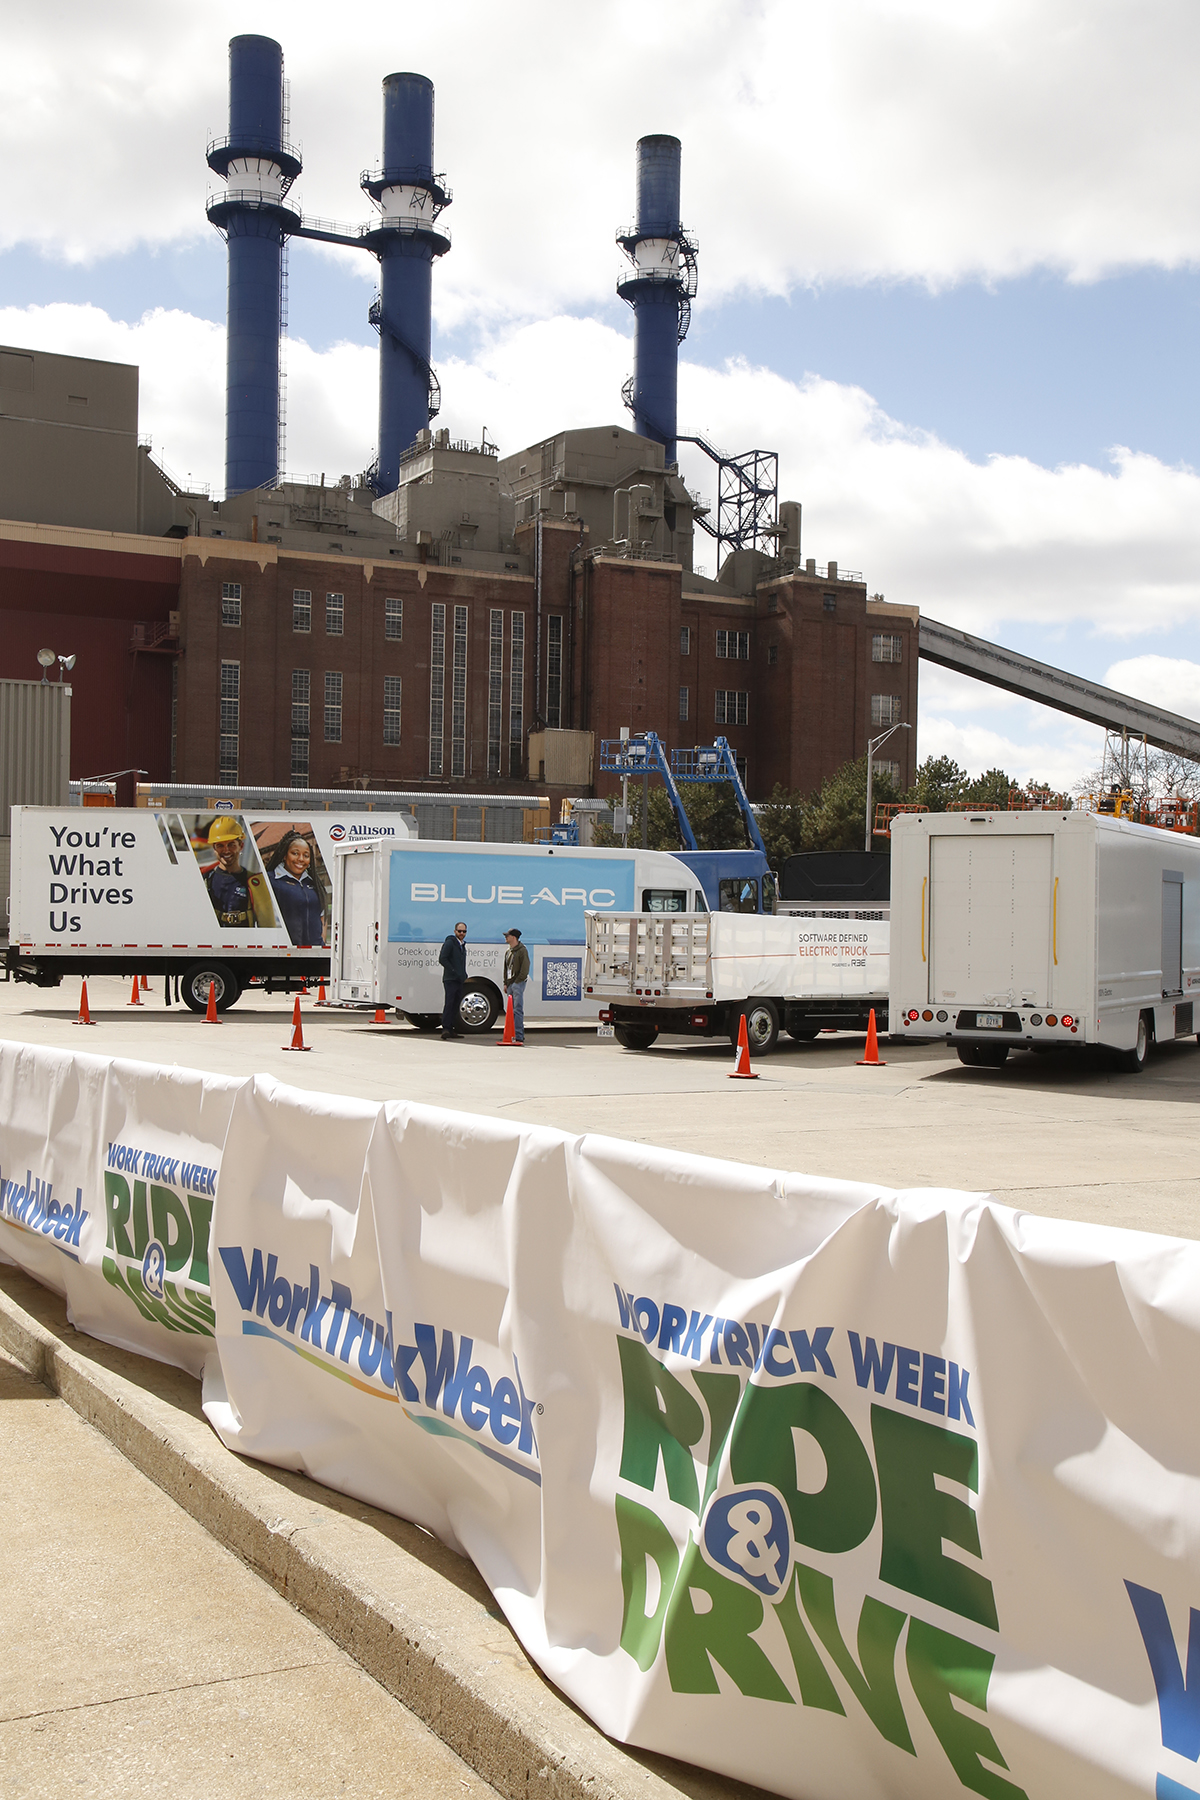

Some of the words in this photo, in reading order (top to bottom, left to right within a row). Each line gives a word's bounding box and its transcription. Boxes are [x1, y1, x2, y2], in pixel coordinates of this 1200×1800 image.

[349, 825, 395, 836] Allison
[49, 854, 123, 876] What
[50, 882, 134, 905] Drives
[411, 883, 524, 905] BLUE
[530, 887, 616, 907] ARC
[49, 911, 82, 932] Us
[798, 934, 837, 943] SOFTWARE
[839, 934, 868, 943] DEFINED
[398, 947, 423, 956] Check
[424, 948, 437, 956] out
[799, 946, 838, 957] ELECTRIC
[840, 946, 868, 957] TRUCK
[397, 959, 424, 968] saying
[468, 959, 483, 967] Arc
[484, 958, 496, 967] EV!
[107, 1142, 143, 1174] WORK
[141, 1152, 181, 1185] TRUCK
[181, 1161, 217, 1195] WEEK
[104, 1170, 214, 1286] RIDE
[613, 1282, 714, 1362] WORK
[710, 1317, 837, 1379] TRUCK
[847, 1329, 977, 1430] WEEK
[616, 1334, 1000, 1633] RIDE
[615, 1492, 1029, 1800] DRIVE
